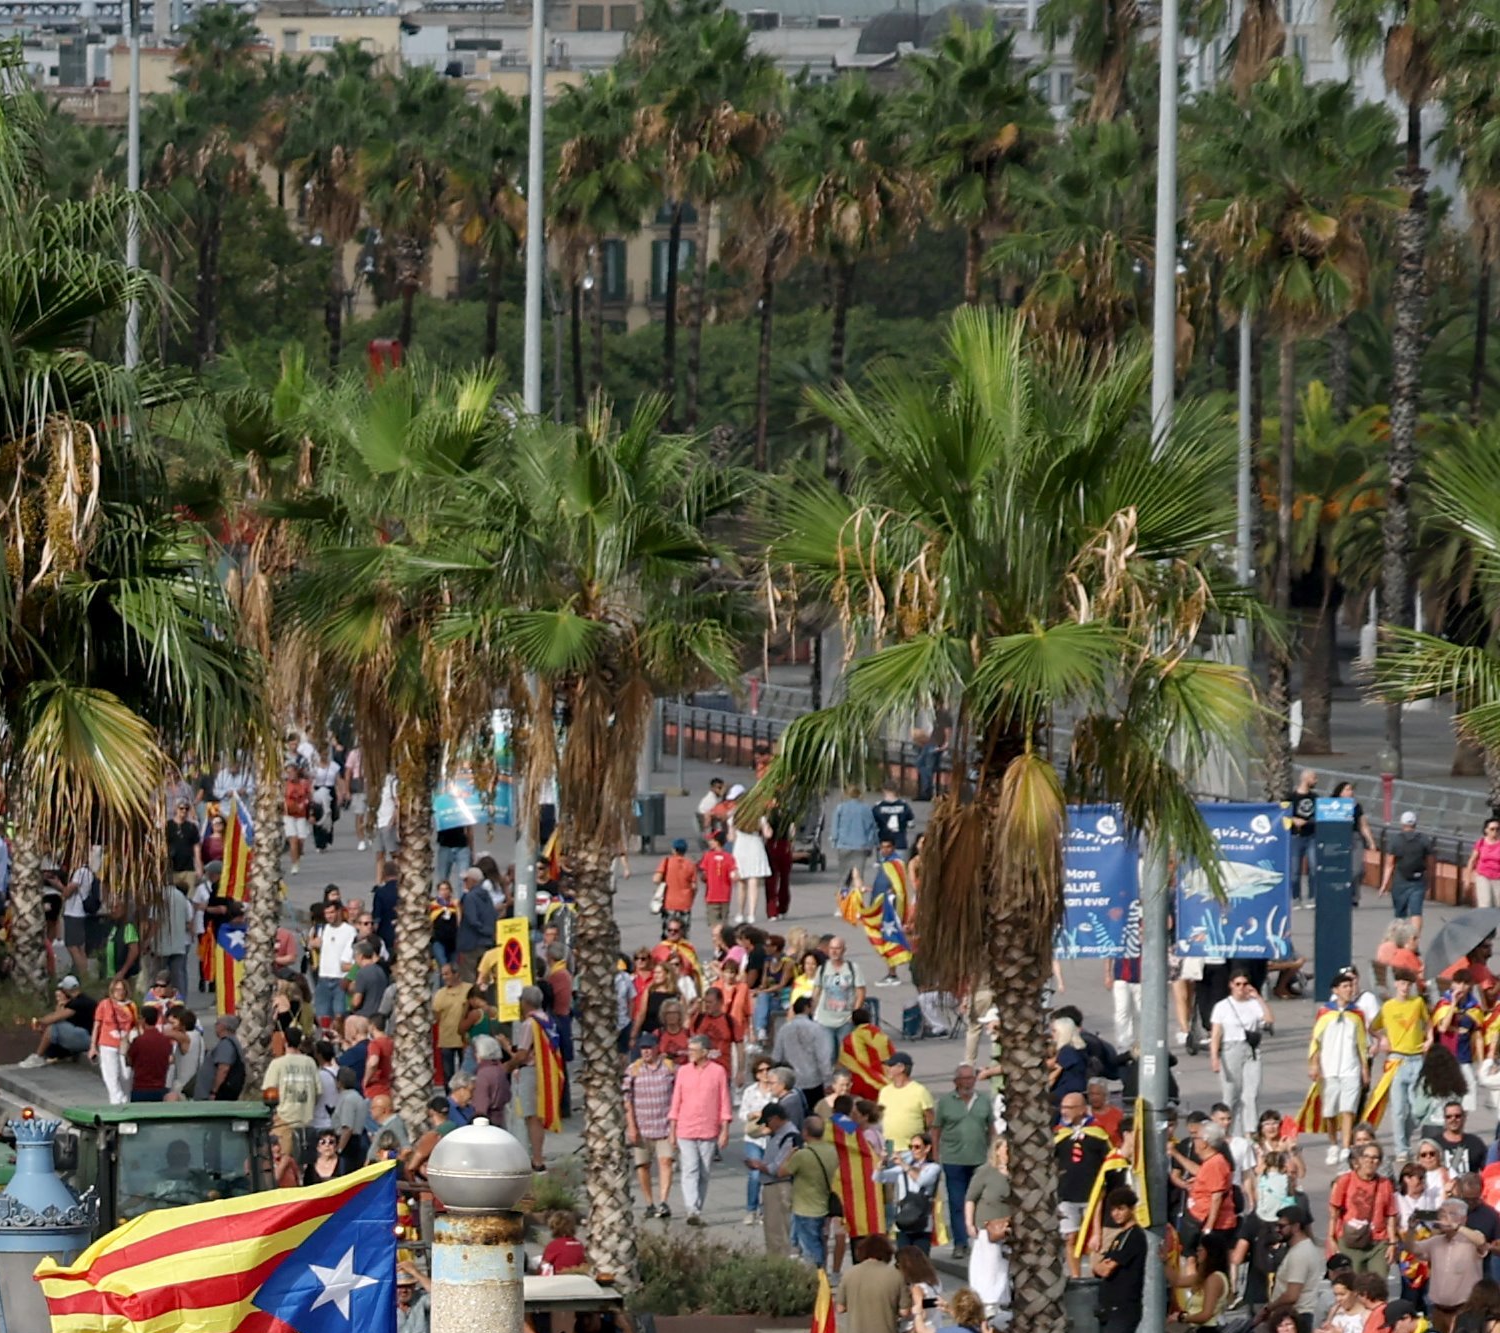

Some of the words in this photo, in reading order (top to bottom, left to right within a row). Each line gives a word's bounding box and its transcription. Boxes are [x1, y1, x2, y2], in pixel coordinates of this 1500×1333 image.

[1067, 868, 1097, 879] More
[1064, 882, 1101, 893] ALIVE
[1064, 897, 1082, 907] an
[1084, 897, 1111, 907] ever
